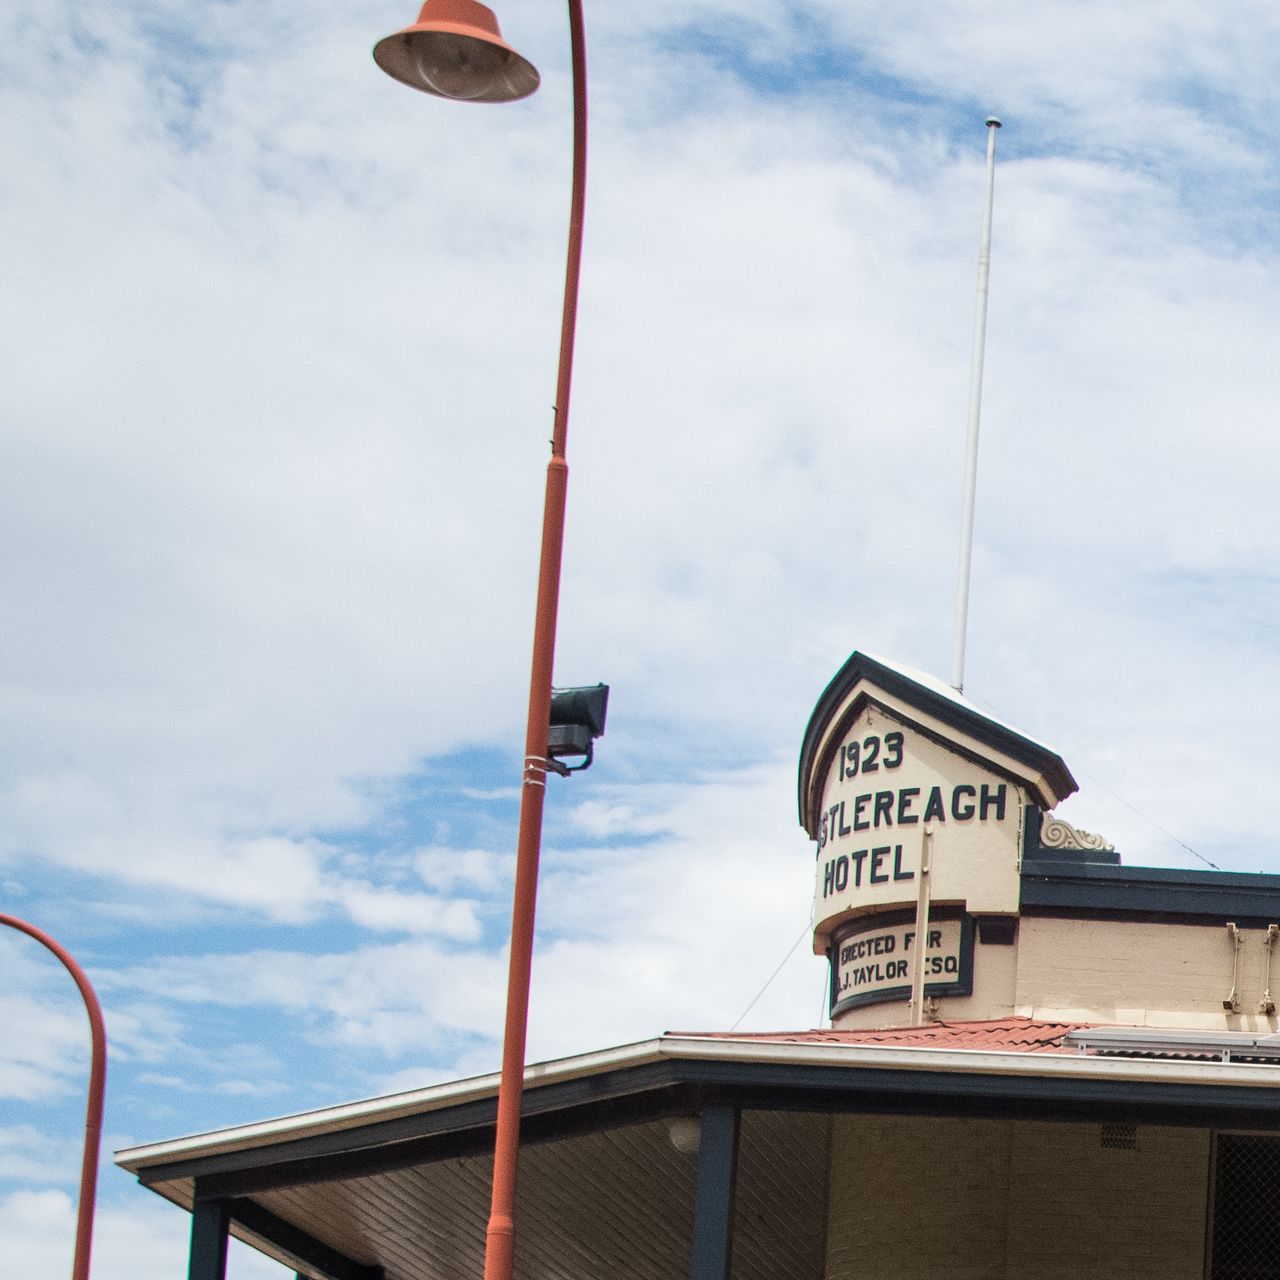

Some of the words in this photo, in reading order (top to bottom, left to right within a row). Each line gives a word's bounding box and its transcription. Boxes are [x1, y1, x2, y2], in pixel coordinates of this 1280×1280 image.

[839, 731, 905, 782] 1923
[819, 784, 1007, 848] STLEREAGH
[823, 845, 915, 898] HOTEL
[841, 934, 896, 966] ERECTED
[904, 930, 942, 951] FR
